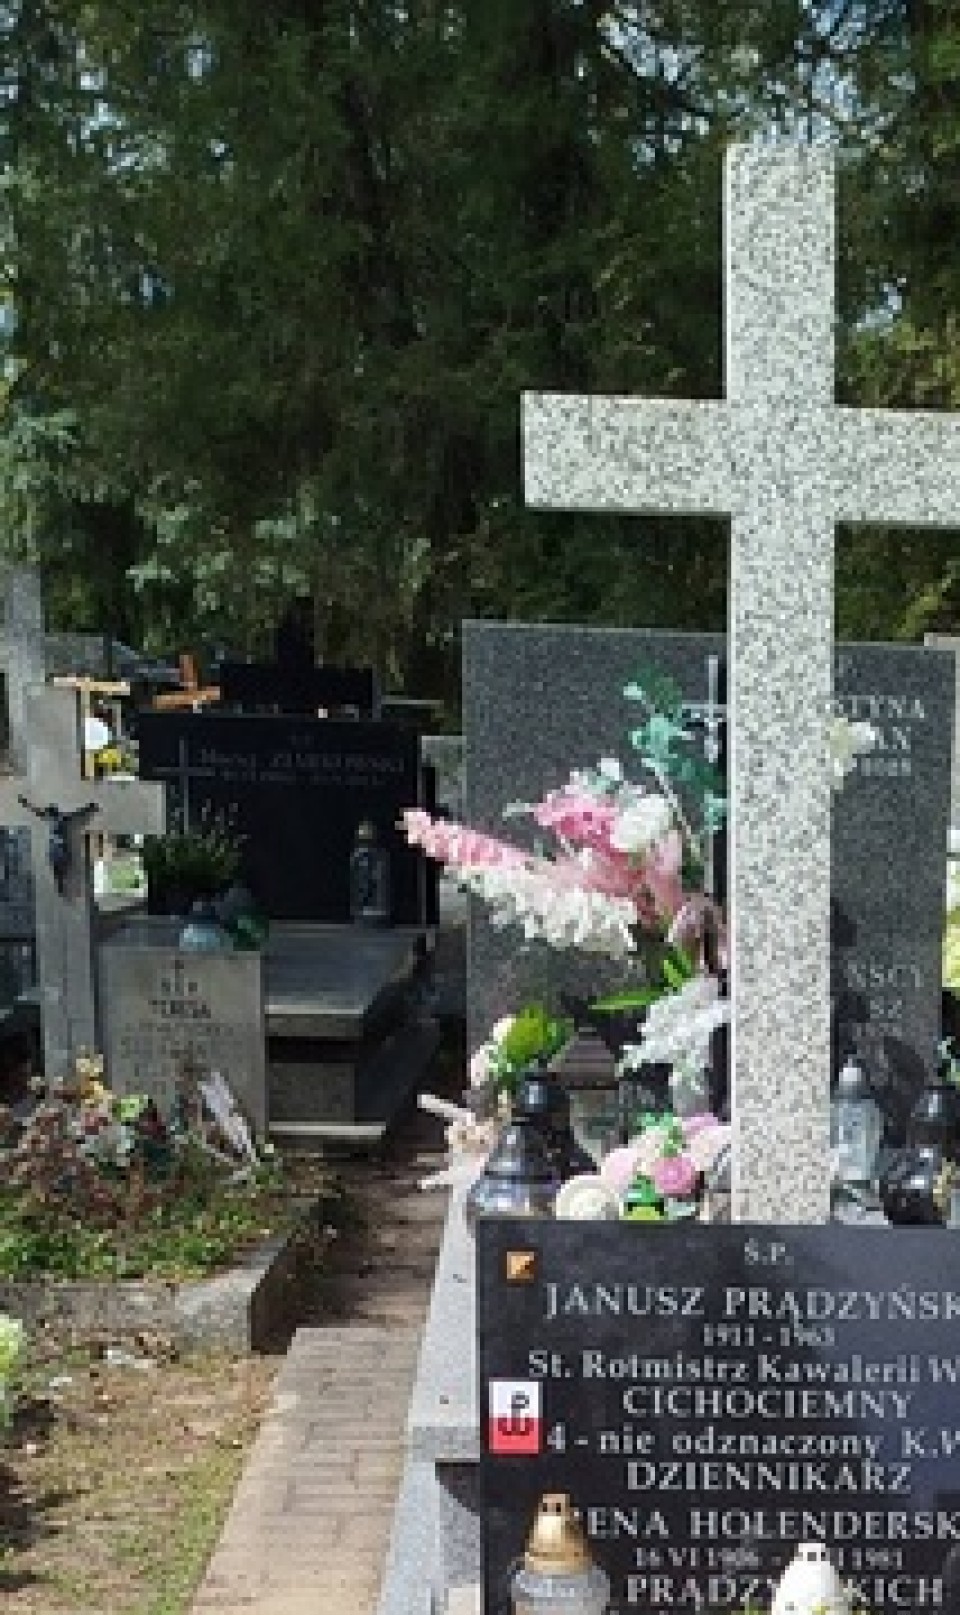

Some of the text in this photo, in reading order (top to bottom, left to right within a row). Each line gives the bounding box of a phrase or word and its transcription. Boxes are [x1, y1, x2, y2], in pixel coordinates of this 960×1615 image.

[545, 1283, 706, 1321] JANUSZ
[702, 1324, 757, 1348] 1911
[528, 1348, 574, 1379] St.
[581, 1350, 750, 1382] Rotmistrz
[756, 1353, 922, 1384] Kawalerii
[621, 1385, 913, 1419] CICHOCIEMNY
[671, 1426, 883, 1461] odznaczony
[626, 1460, 912, 1492] DZIENNIKARZ
[572, 1506, 670, 1538] ENA
